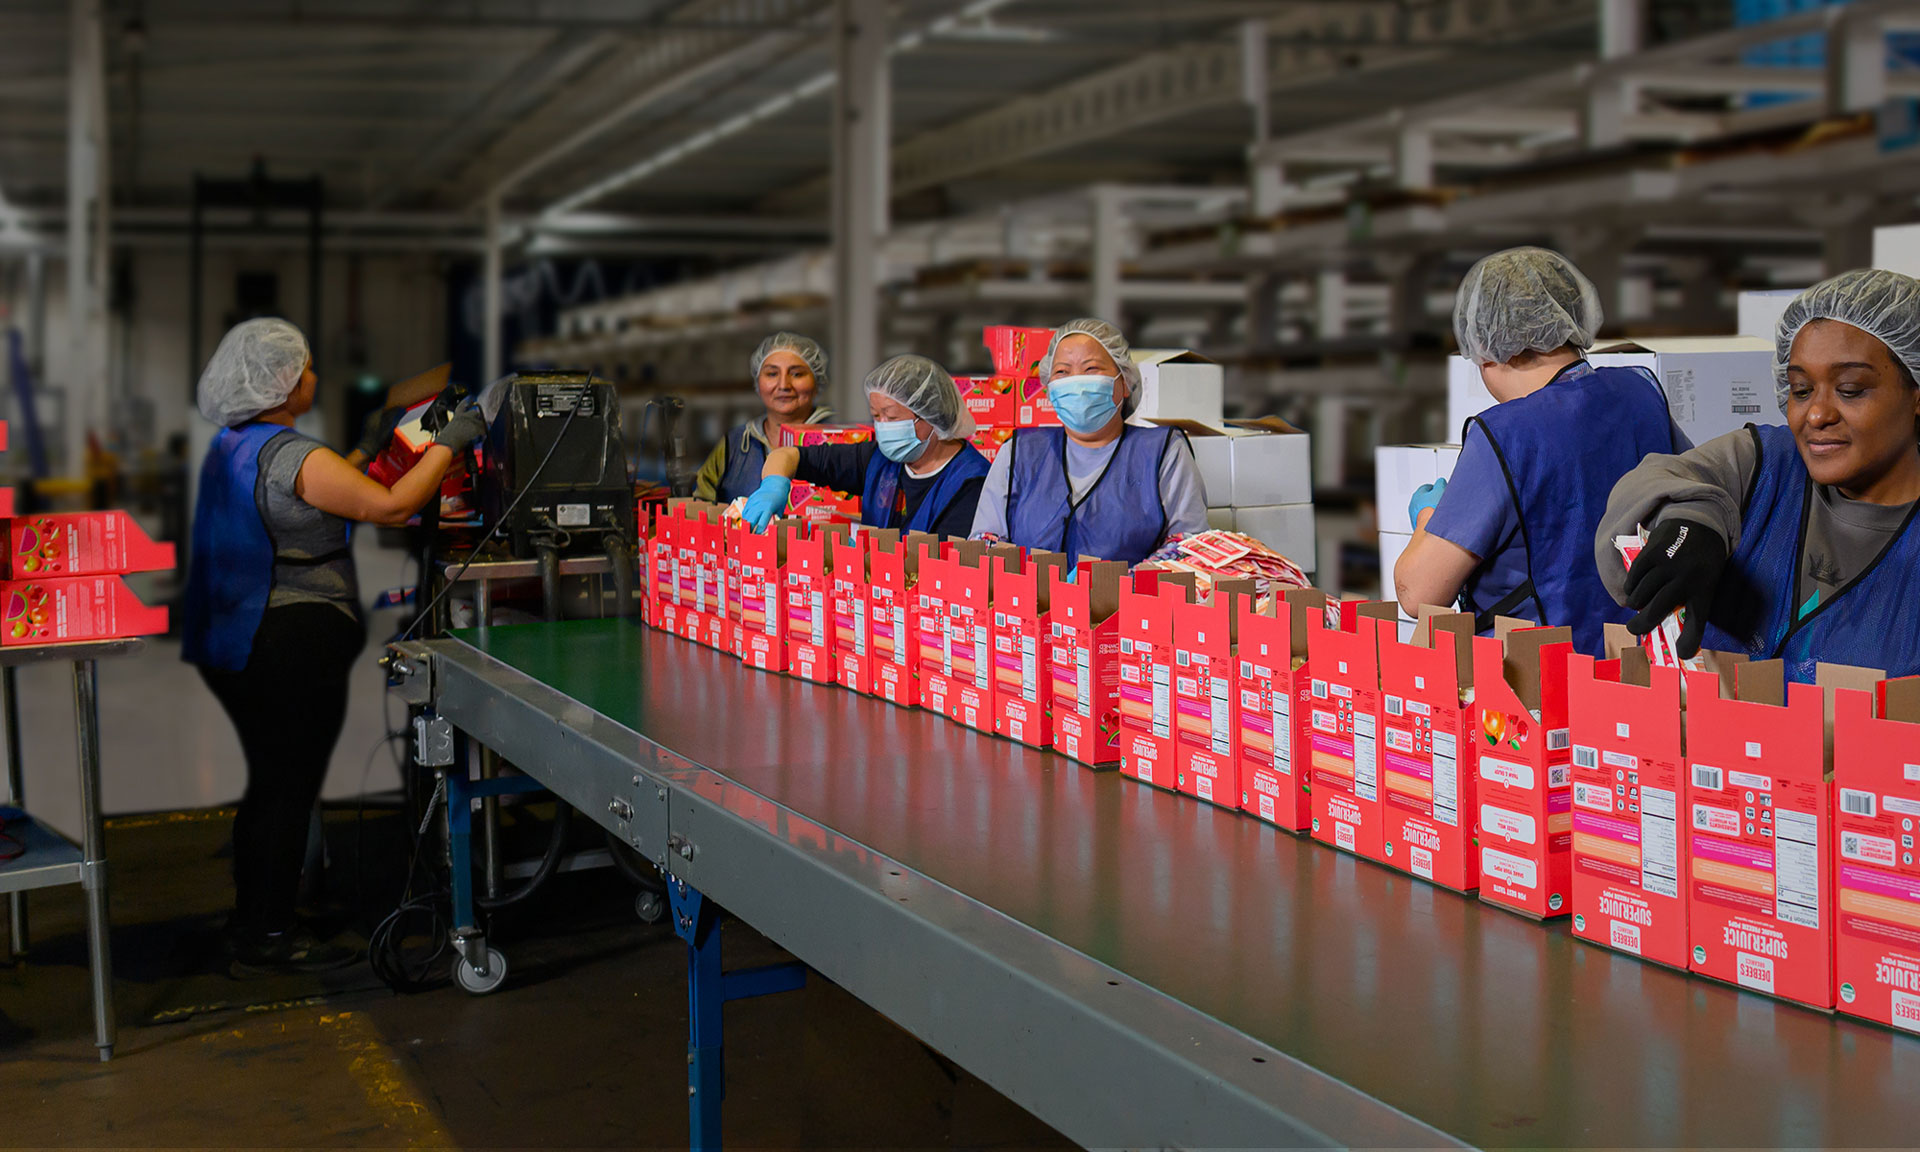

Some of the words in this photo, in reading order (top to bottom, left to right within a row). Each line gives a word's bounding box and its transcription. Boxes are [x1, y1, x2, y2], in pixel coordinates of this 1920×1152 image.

[1665, 525, 1689, 559] OCTOGRIP
[1328, 802, 1362, 827] SUPERJUICE
[1402, 826, 1441, 852] SUPERJUICE
[1599, 896, 1652, 927] SUPERJUICE
[1722, 927, 1789, 960] SUPERJUICE
